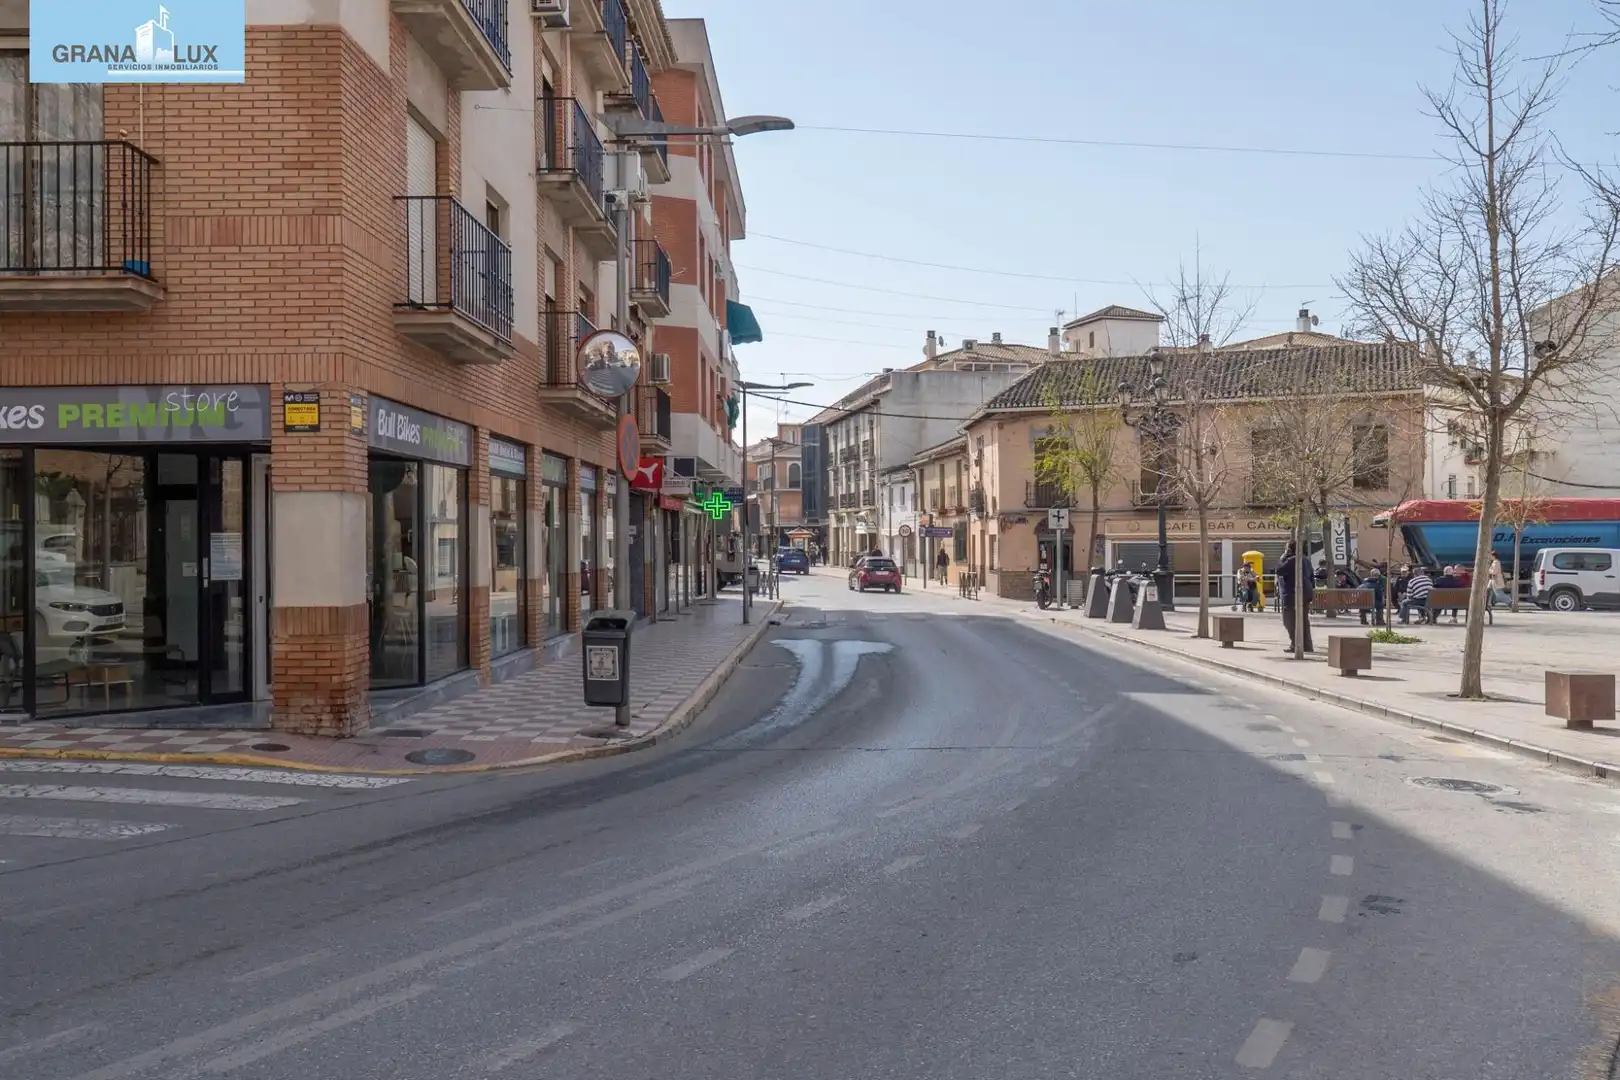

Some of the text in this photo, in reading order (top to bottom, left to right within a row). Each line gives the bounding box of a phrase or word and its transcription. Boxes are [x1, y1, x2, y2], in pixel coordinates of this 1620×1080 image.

[164, 387, 240, 412] store
[58, 402, 226, 429] PREMIUM
[377, 408, 396, 438] Bull
[396, 413, 420, 445] Bikes
[1207, 521, 1235, 531] BAR
